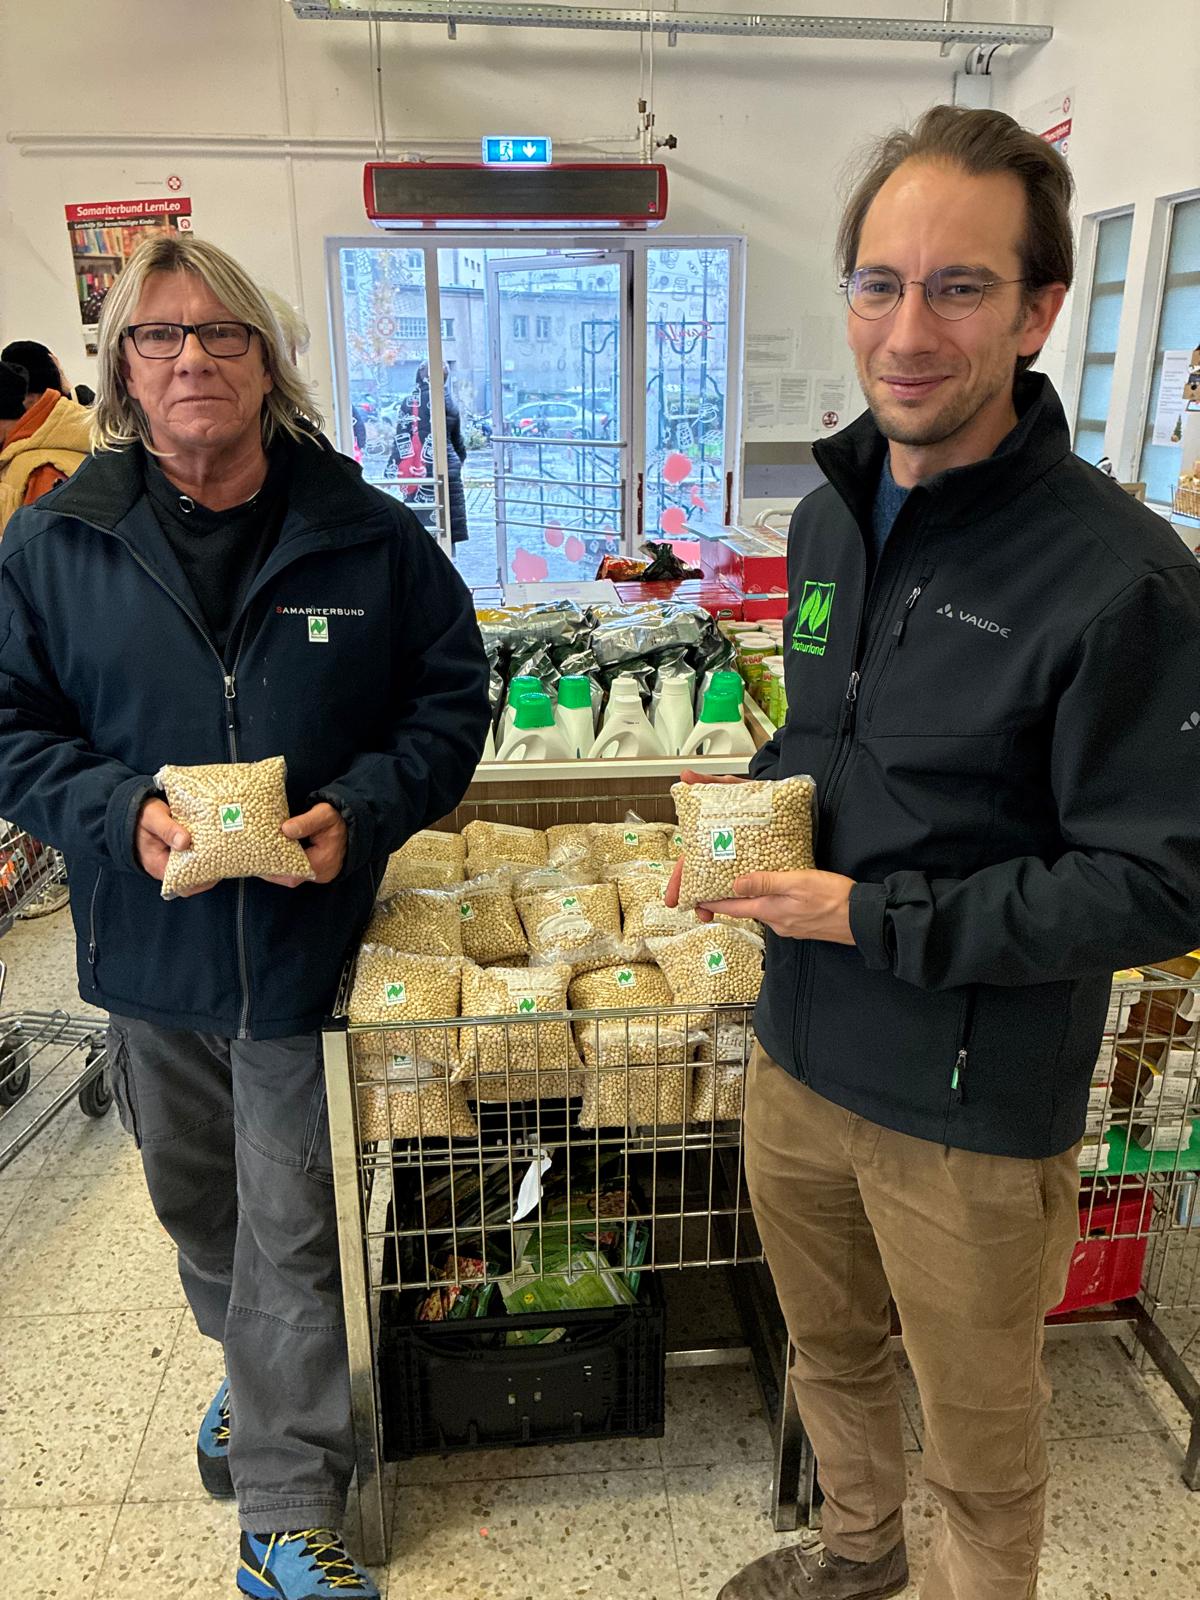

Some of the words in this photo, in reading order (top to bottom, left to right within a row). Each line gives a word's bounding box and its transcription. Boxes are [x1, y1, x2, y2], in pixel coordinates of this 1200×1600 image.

[77, 204, 142, 216] Samariterbund
[145, 201, 180, 212] LernLeo
[275, 606, 365, 616] SAMARITERBUND
[960, 611, 1012, 639] VAUDE
[791, 639, 826, 656] Naturland
